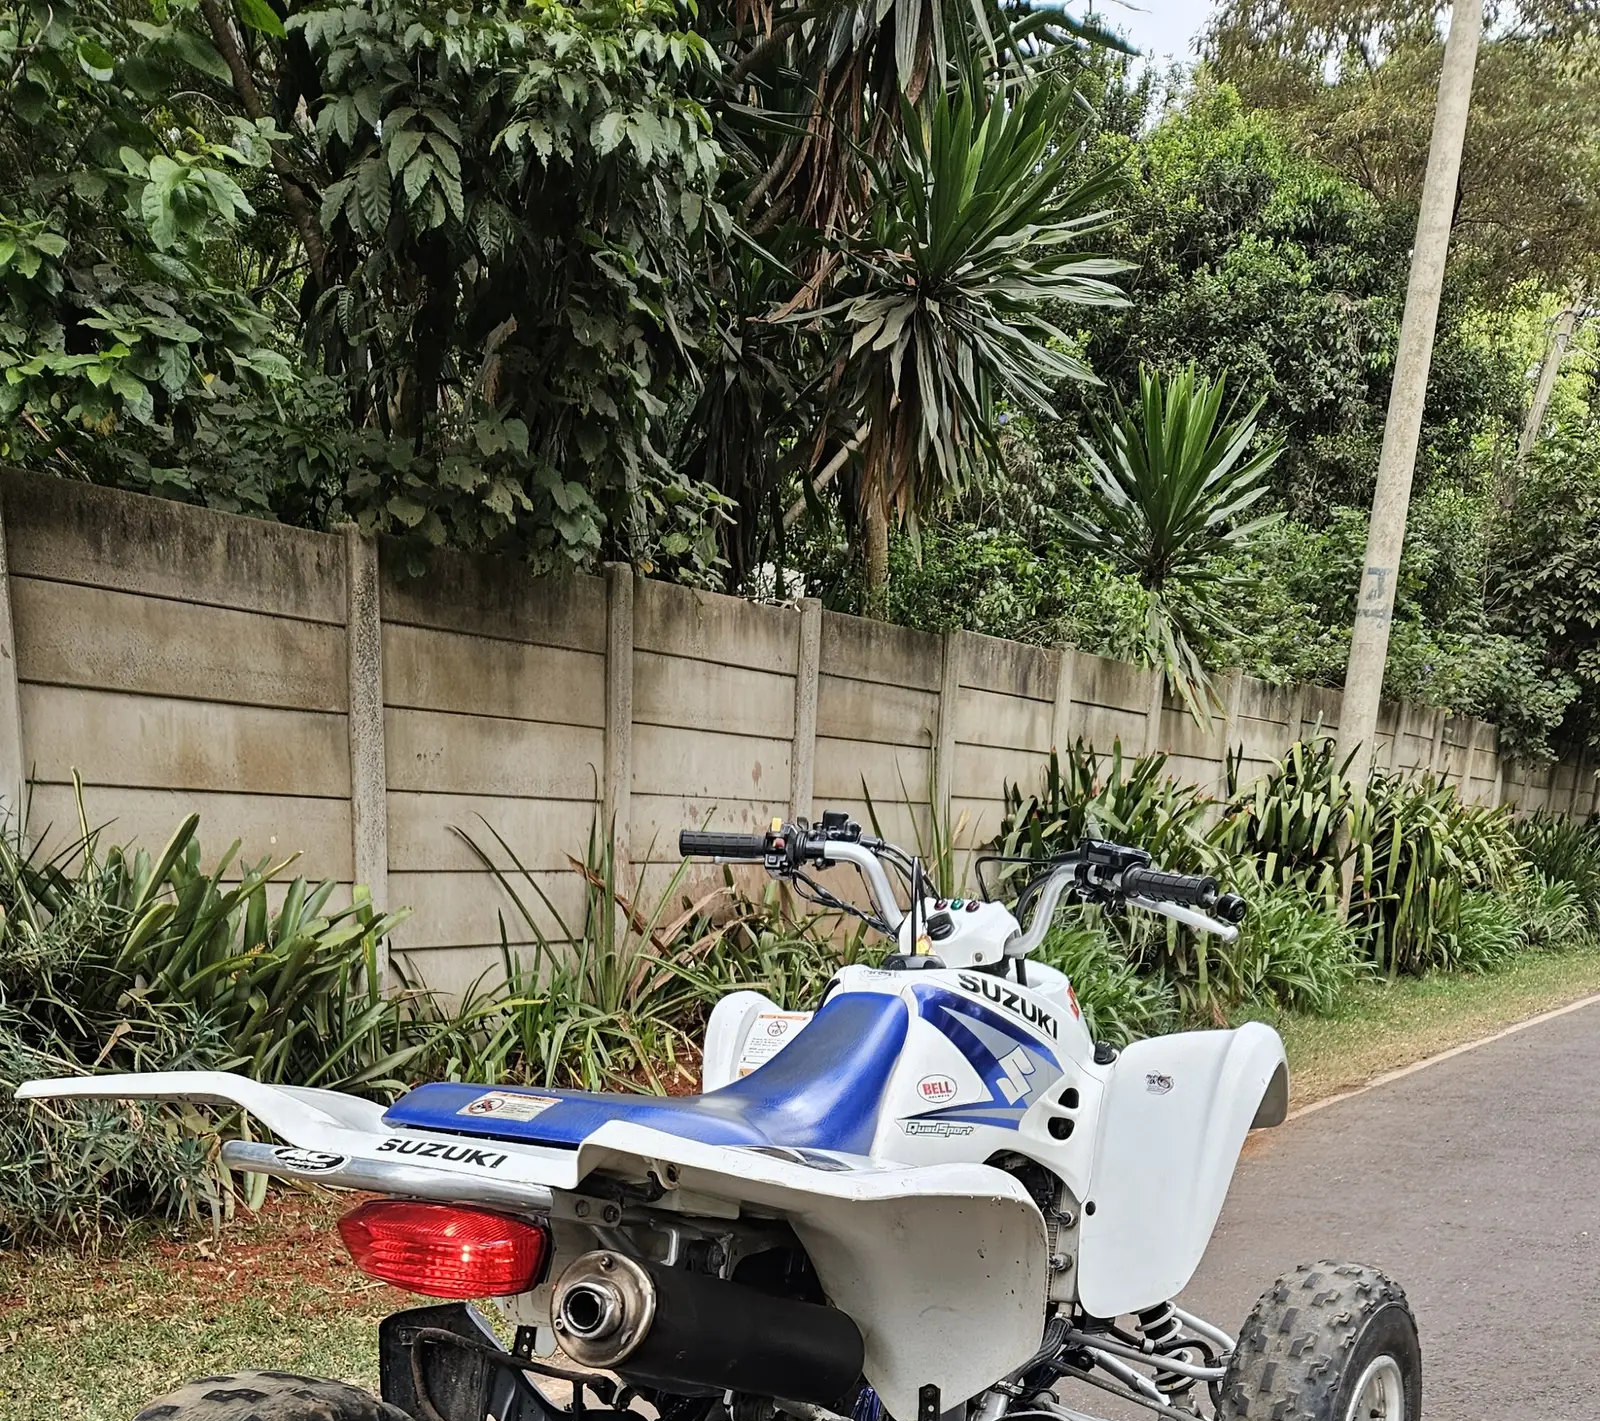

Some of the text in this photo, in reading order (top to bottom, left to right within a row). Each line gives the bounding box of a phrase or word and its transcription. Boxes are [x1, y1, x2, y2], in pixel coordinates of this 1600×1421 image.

[957, 973, 1058, 1041] SUZUKI
[922, 1081, 952, 1096] BELL
[905, 1121, 975, 1138] QuadSport
[376, 1138, 509, 1169] SUZUKI
